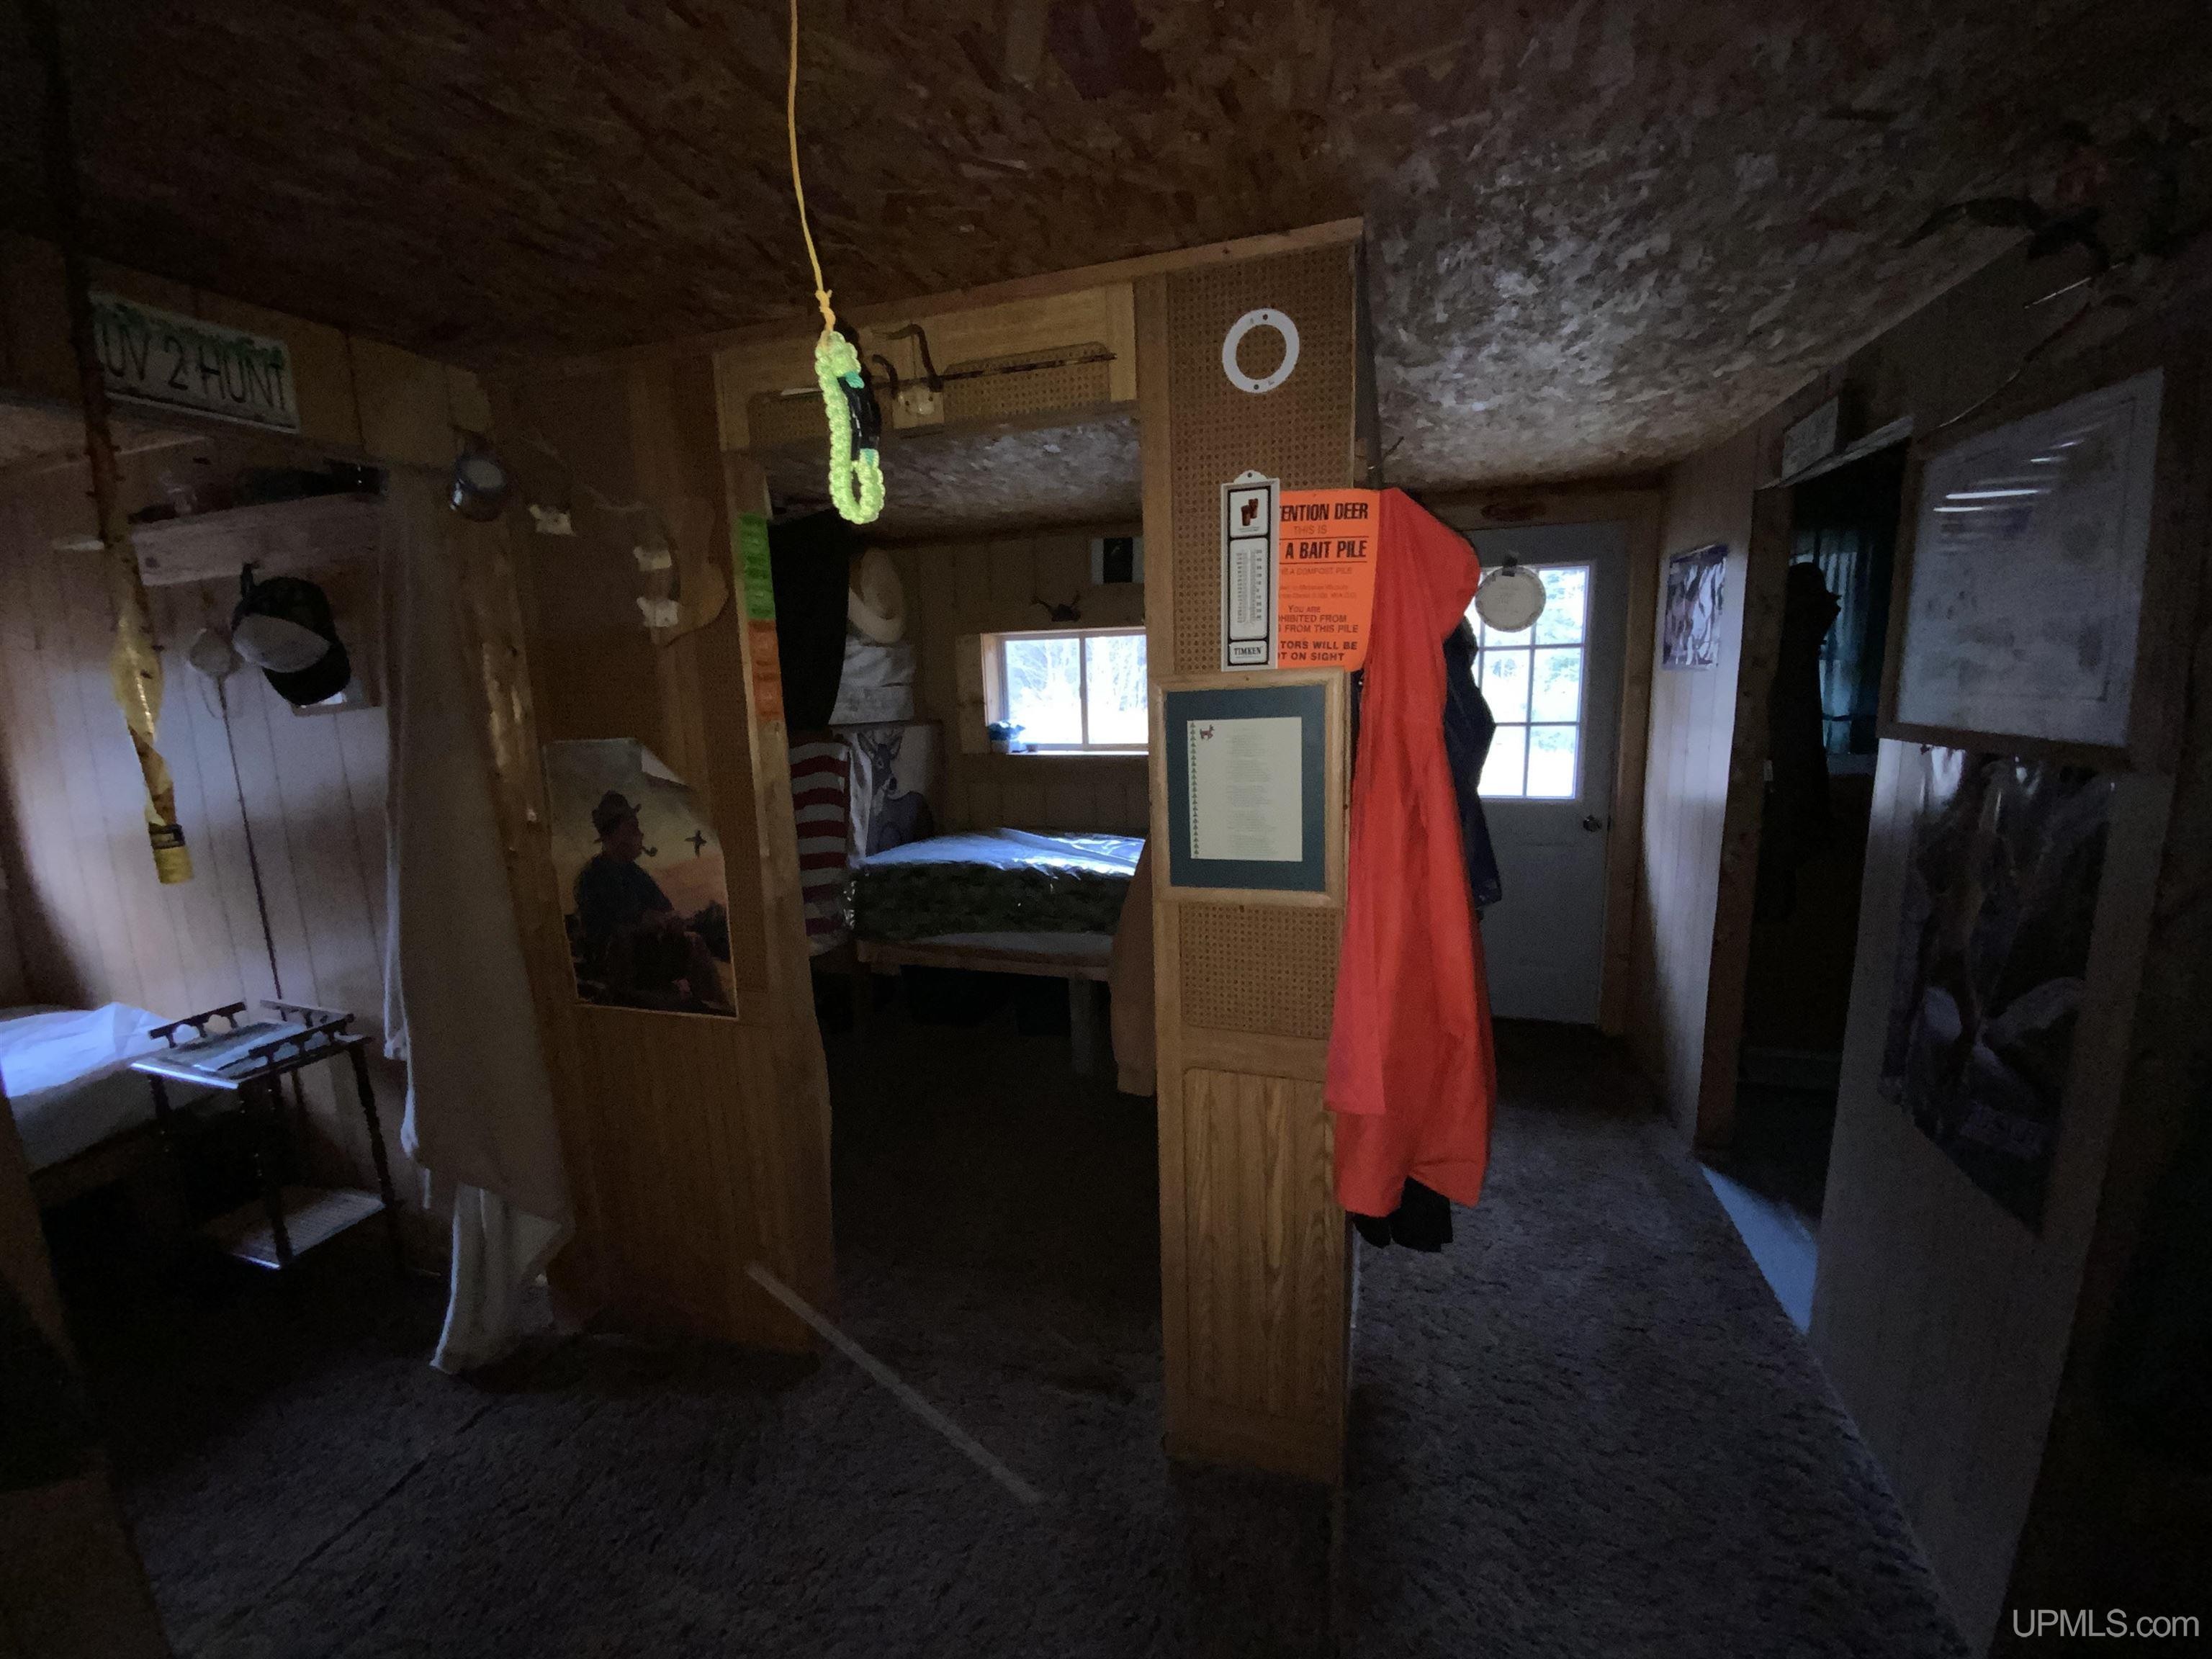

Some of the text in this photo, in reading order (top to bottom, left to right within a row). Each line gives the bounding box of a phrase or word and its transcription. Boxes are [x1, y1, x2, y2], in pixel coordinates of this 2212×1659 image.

[102, 322, 286, 411] UV 2 HUNT
[1334, 503, 1369, 520] DEER
[1294, 525, 1328, 535] THIS IS
[1285, 540, 1368, 559] A BAIT PILE
[1319, 614, 1347, 623] FROM
[1314, 624, 1335, 633] THIS
[1338, 624, 1359, 633] PILE
[1313, 641, 1339, 650] WILL
[1343, 642, 1358, 650] BE
[1233, 646, 1262, 655] TIMKEN
[1310, 652, 1346, 661] SIGHT
